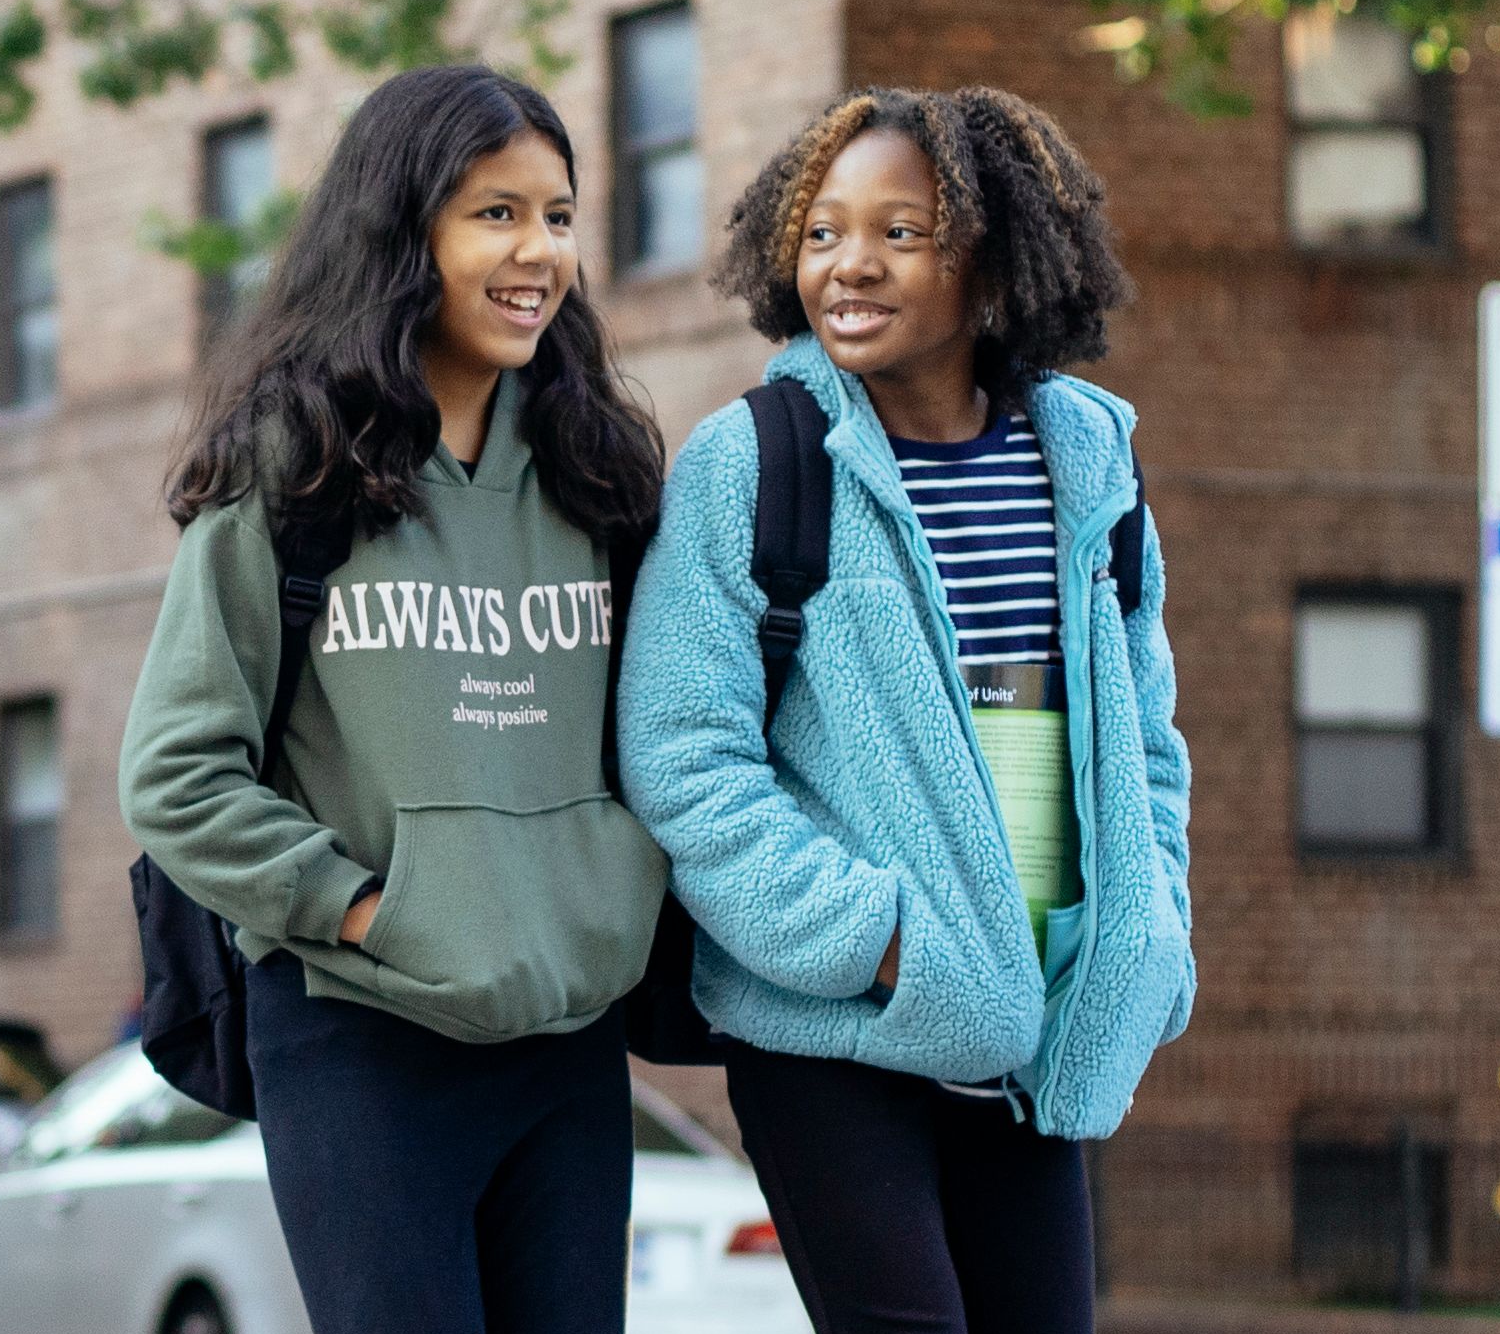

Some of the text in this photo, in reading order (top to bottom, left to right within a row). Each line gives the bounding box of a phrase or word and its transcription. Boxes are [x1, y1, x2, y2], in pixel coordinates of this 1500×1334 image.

[322, 581, 511, 657] ALWAYS
[460, 672, 535, 700] always cool
[453, 702, 548, 731] always positive
